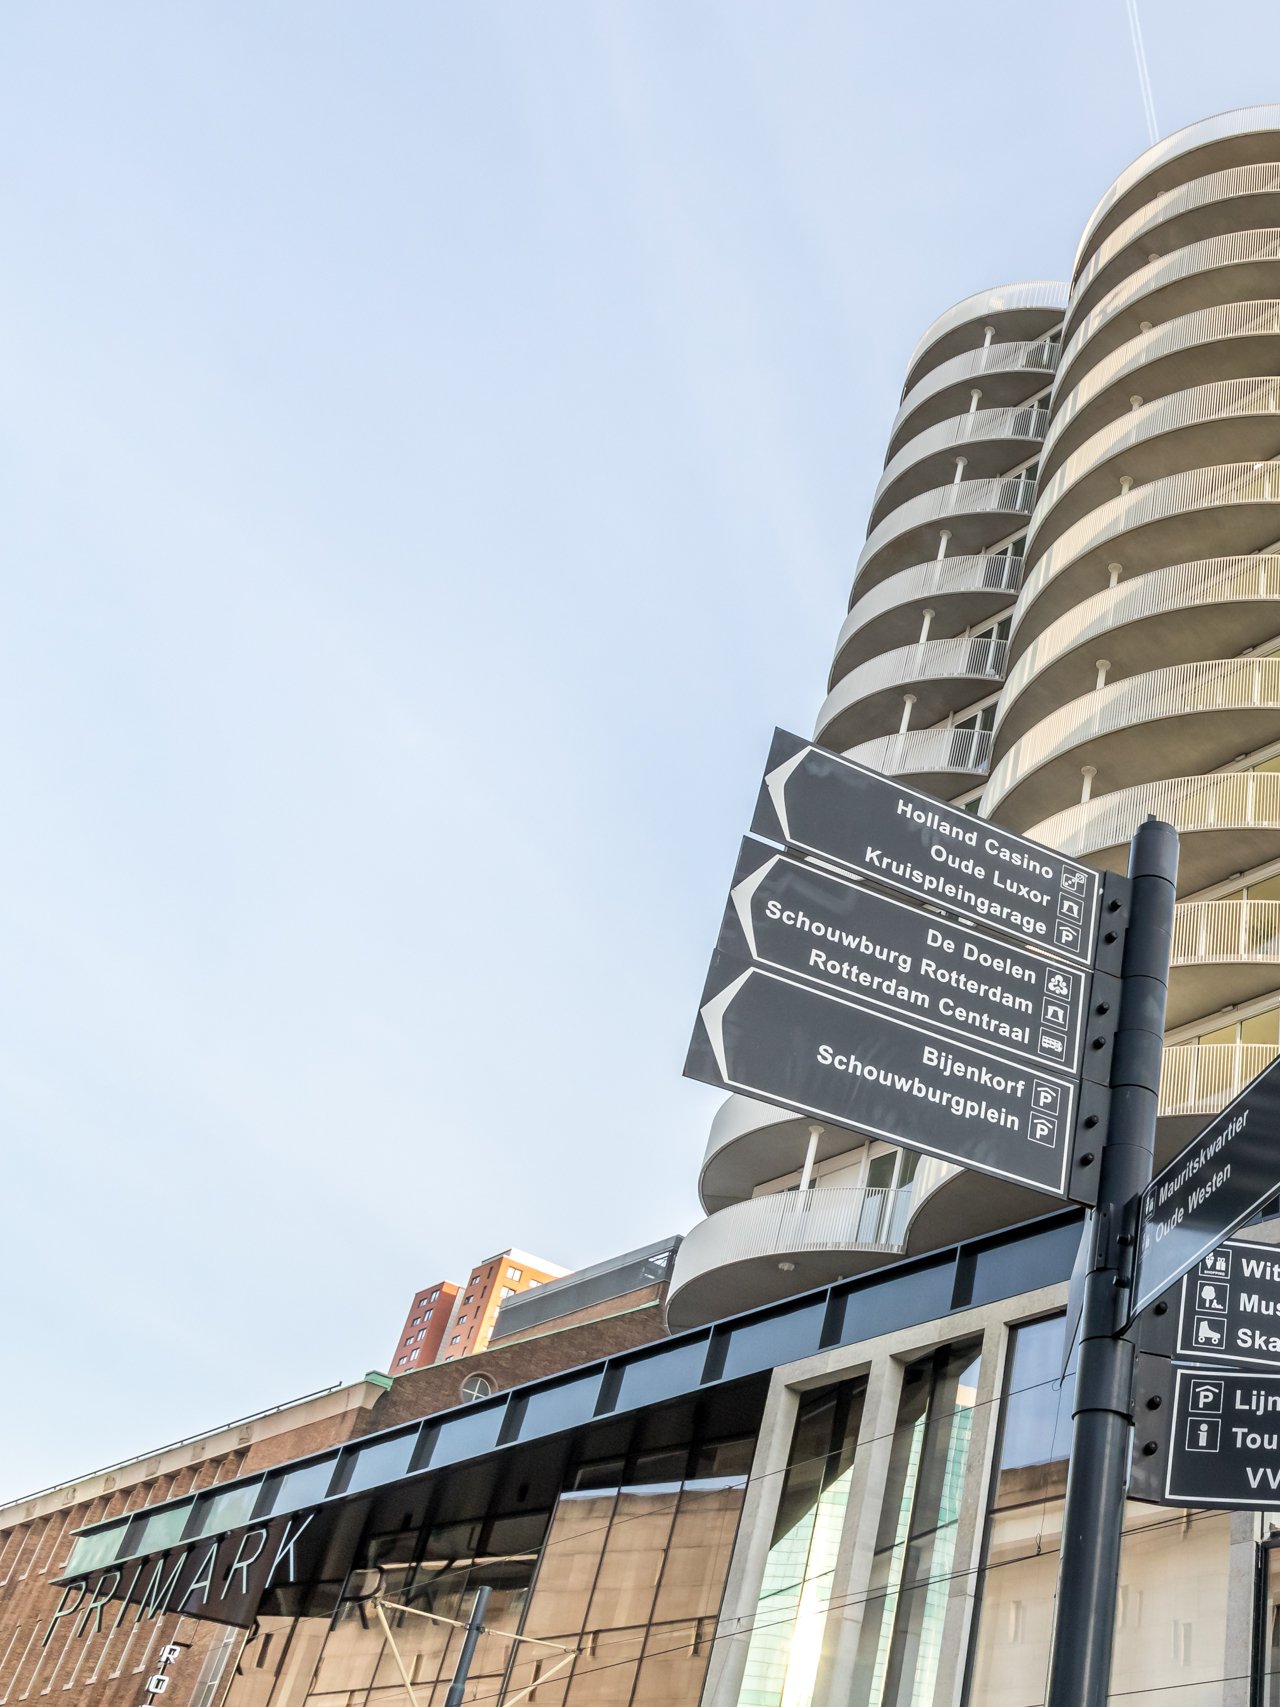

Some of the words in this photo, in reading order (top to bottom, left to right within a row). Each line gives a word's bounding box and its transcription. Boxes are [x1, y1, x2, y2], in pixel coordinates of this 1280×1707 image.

[896, 798, 978, 847] Holland
[984, 838, 1054, 879] Casino
[930, 844, 986, 880] Oude
[993, 870, 1051, 907] Luxor
[864, 846, 1047, 935] Kruispleingarage
[765, 900, 913, 973] Schouwburg
[920, 958, 1033, 1015] Rotterdam
[808, 948, 930, 1009] Rotterdam
[938, 997, 1030, 1045] Centraal
[926, 928, 956, 953] De
[963, 942, 1036, 985] Doelen
[816, 1044, 1020, 1131] Schouwburgplein
[922, 1045, 1026, 1098] Bijenkorf
[1158, 1109, 1249, 1207] Mauritskwartier
[1155, 1206, 1185, 1243] Oude
[1187, 1163, 1231, 1214] Westen
[41, 1511, 317, 1647] PRIMARK
